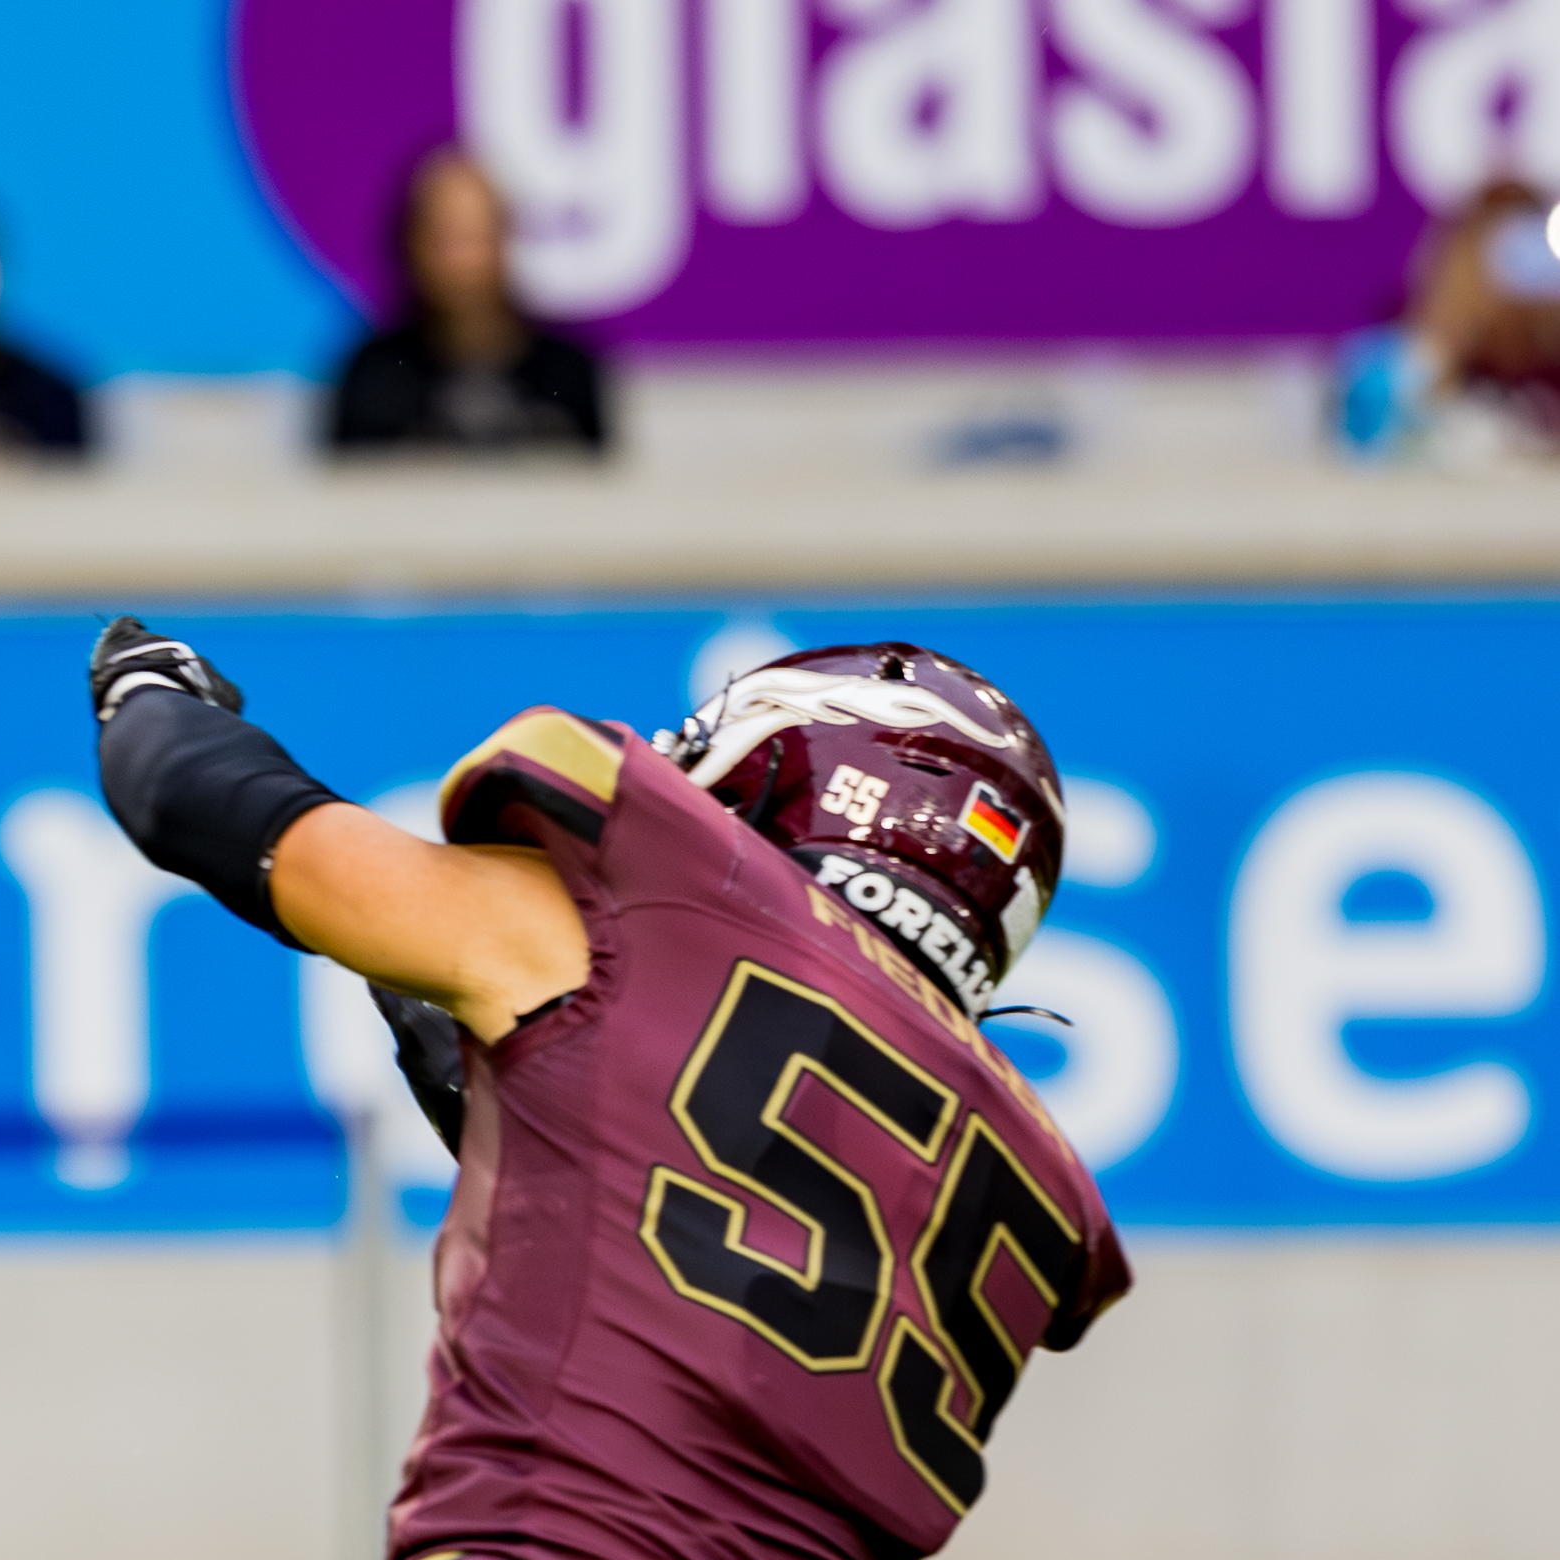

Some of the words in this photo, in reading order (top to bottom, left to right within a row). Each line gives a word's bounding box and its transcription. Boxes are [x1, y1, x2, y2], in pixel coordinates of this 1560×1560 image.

[820, 763, 891, 827] 55
[815, 854, 994, 1026] FORELL
[639, 957, 1084, 1520] 55
